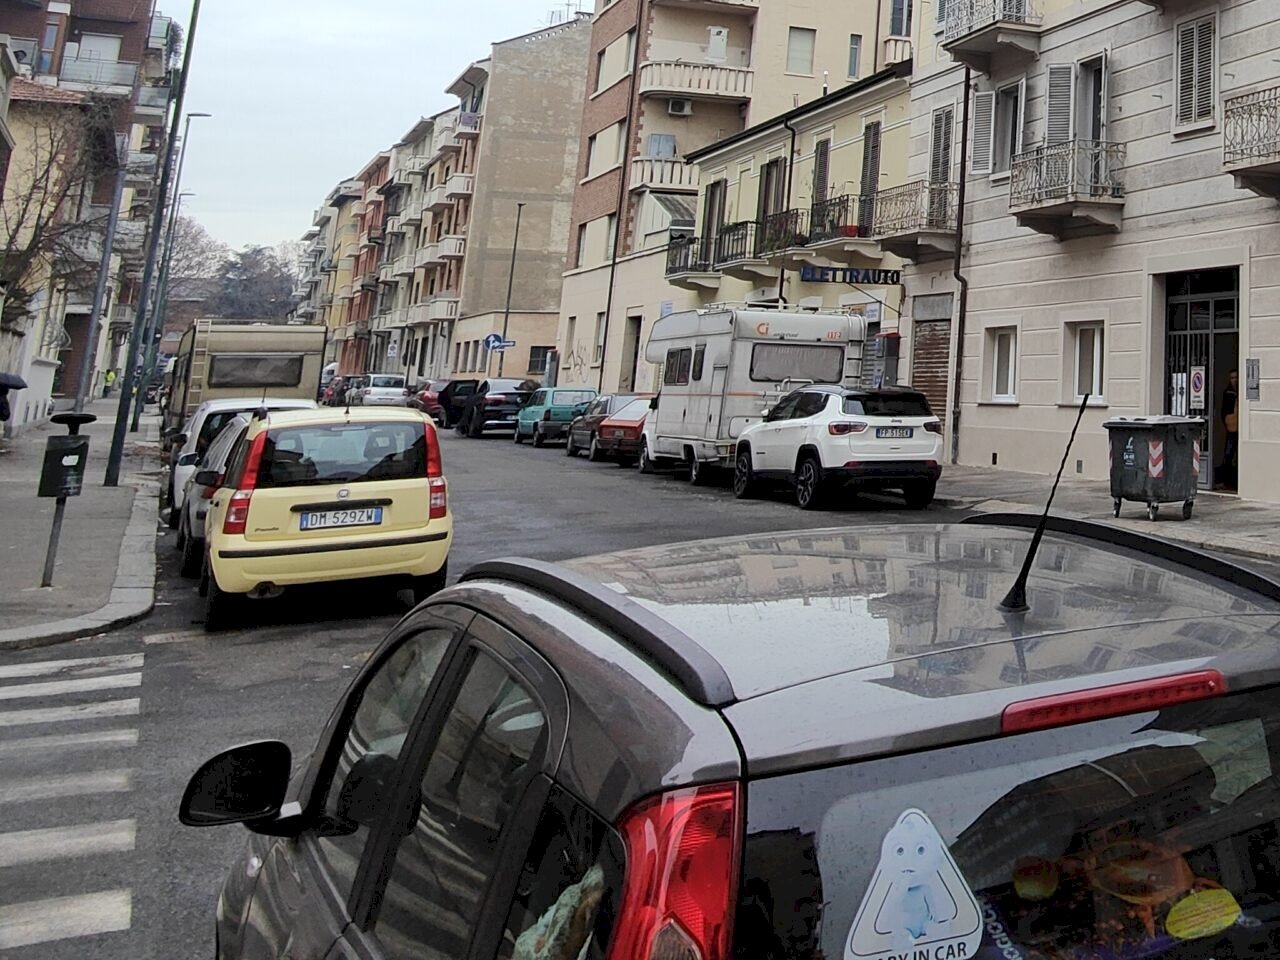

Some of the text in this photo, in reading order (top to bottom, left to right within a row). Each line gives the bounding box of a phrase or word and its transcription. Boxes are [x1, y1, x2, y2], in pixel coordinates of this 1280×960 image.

[801, 266, 900, 284] ELETTRAUTO
[310, 509, 374, 526] DM 529ZW
[913, 941, 967, 960] IN CAR
